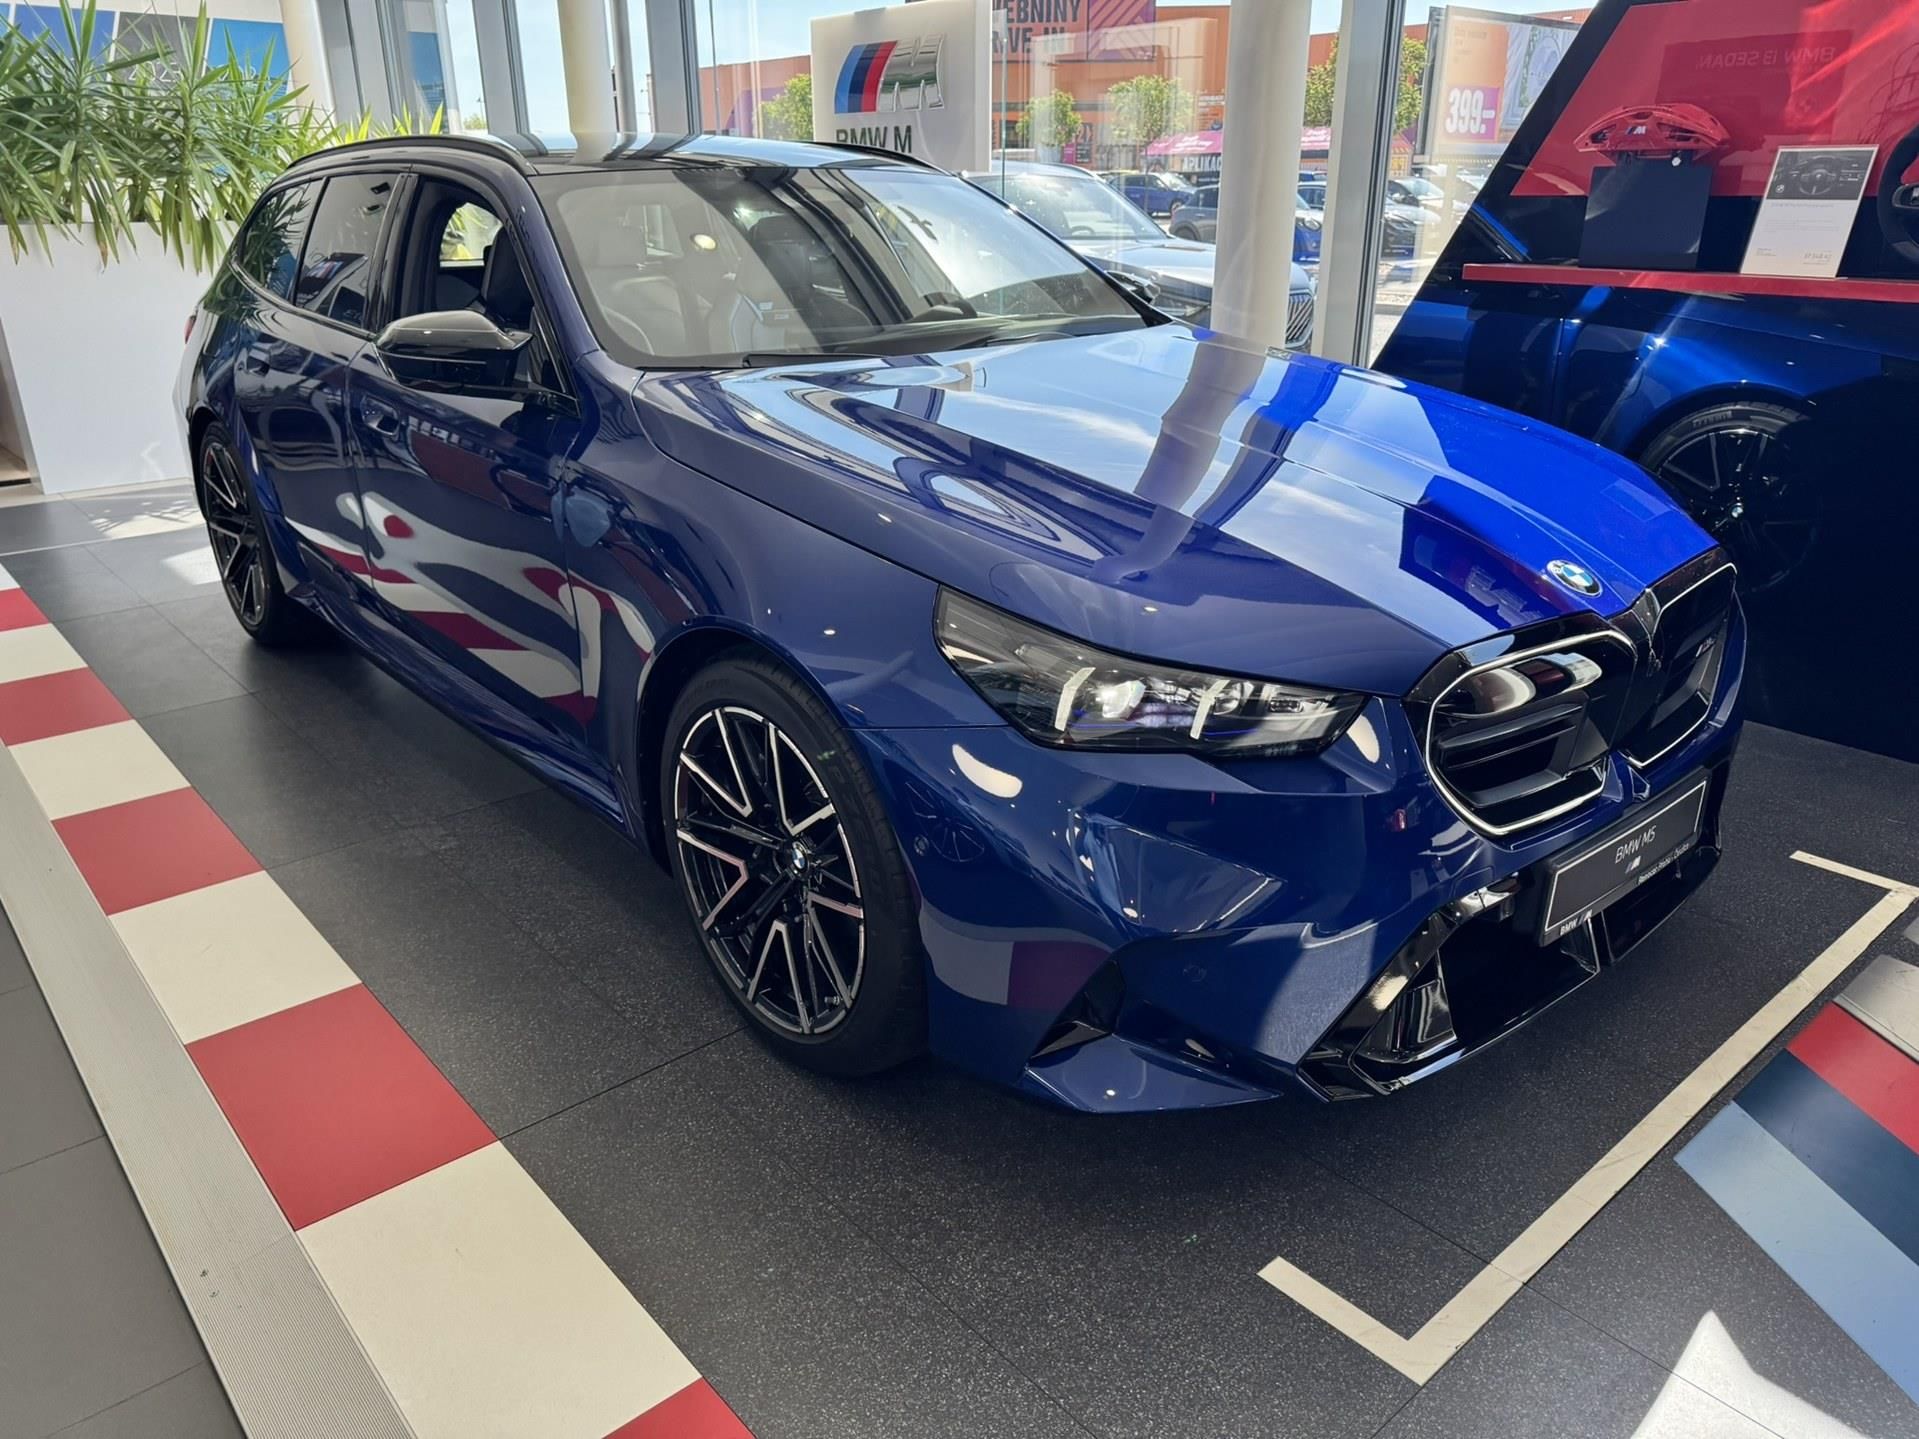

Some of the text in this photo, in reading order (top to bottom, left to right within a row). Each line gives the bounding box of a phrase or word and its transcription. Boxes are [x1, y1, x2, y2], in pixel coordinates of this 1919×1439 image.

[894, 125, 912, 153] M
[1615, 835, 1642, 864] BMW
[1641, 825, 1657, 847] M5
[1560, 918, 1578, 936] BMW
